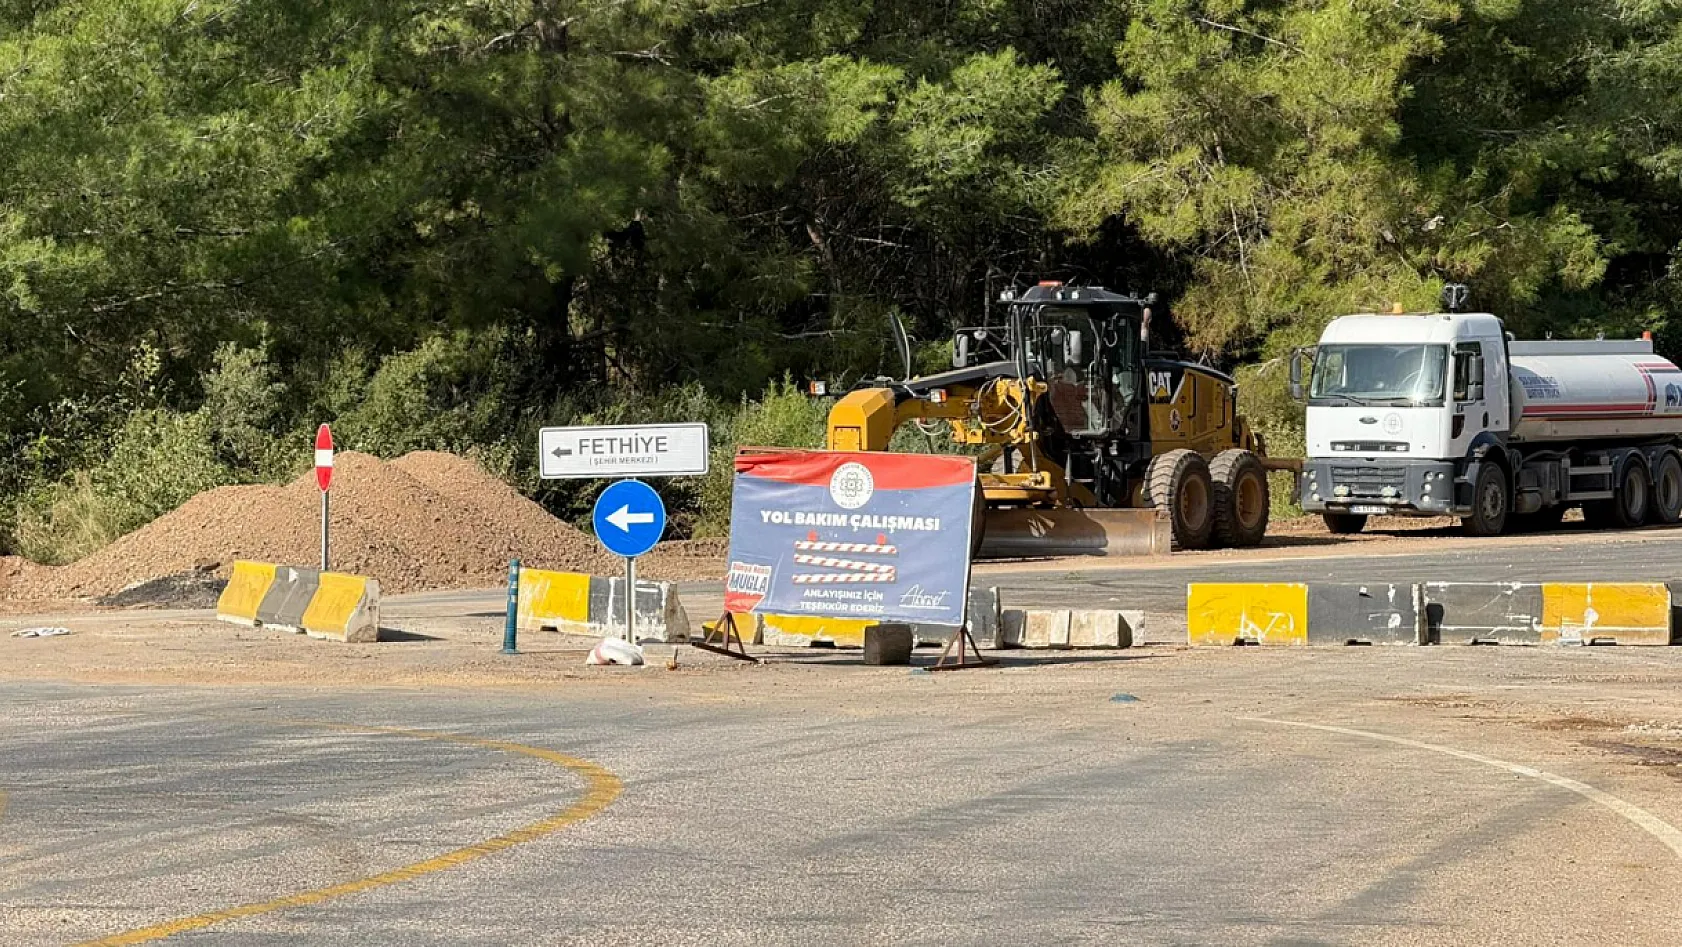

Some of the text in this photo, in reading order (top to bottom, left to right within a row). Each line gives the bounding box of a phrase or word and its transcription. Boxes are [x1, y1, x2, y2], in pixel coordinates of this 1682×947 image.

[1149, 371, 1171, 397] CAT
[579, 433, 668, 454] FETHİYE
[760, 510, 940, 533] YOL BAKIM ÇALIŞMASI
[803, 588, 884, 602] ANLAYIŞINIZ İÇİN
[800, 601, 885, 613] TEŞEKKÜR EDERİZ
